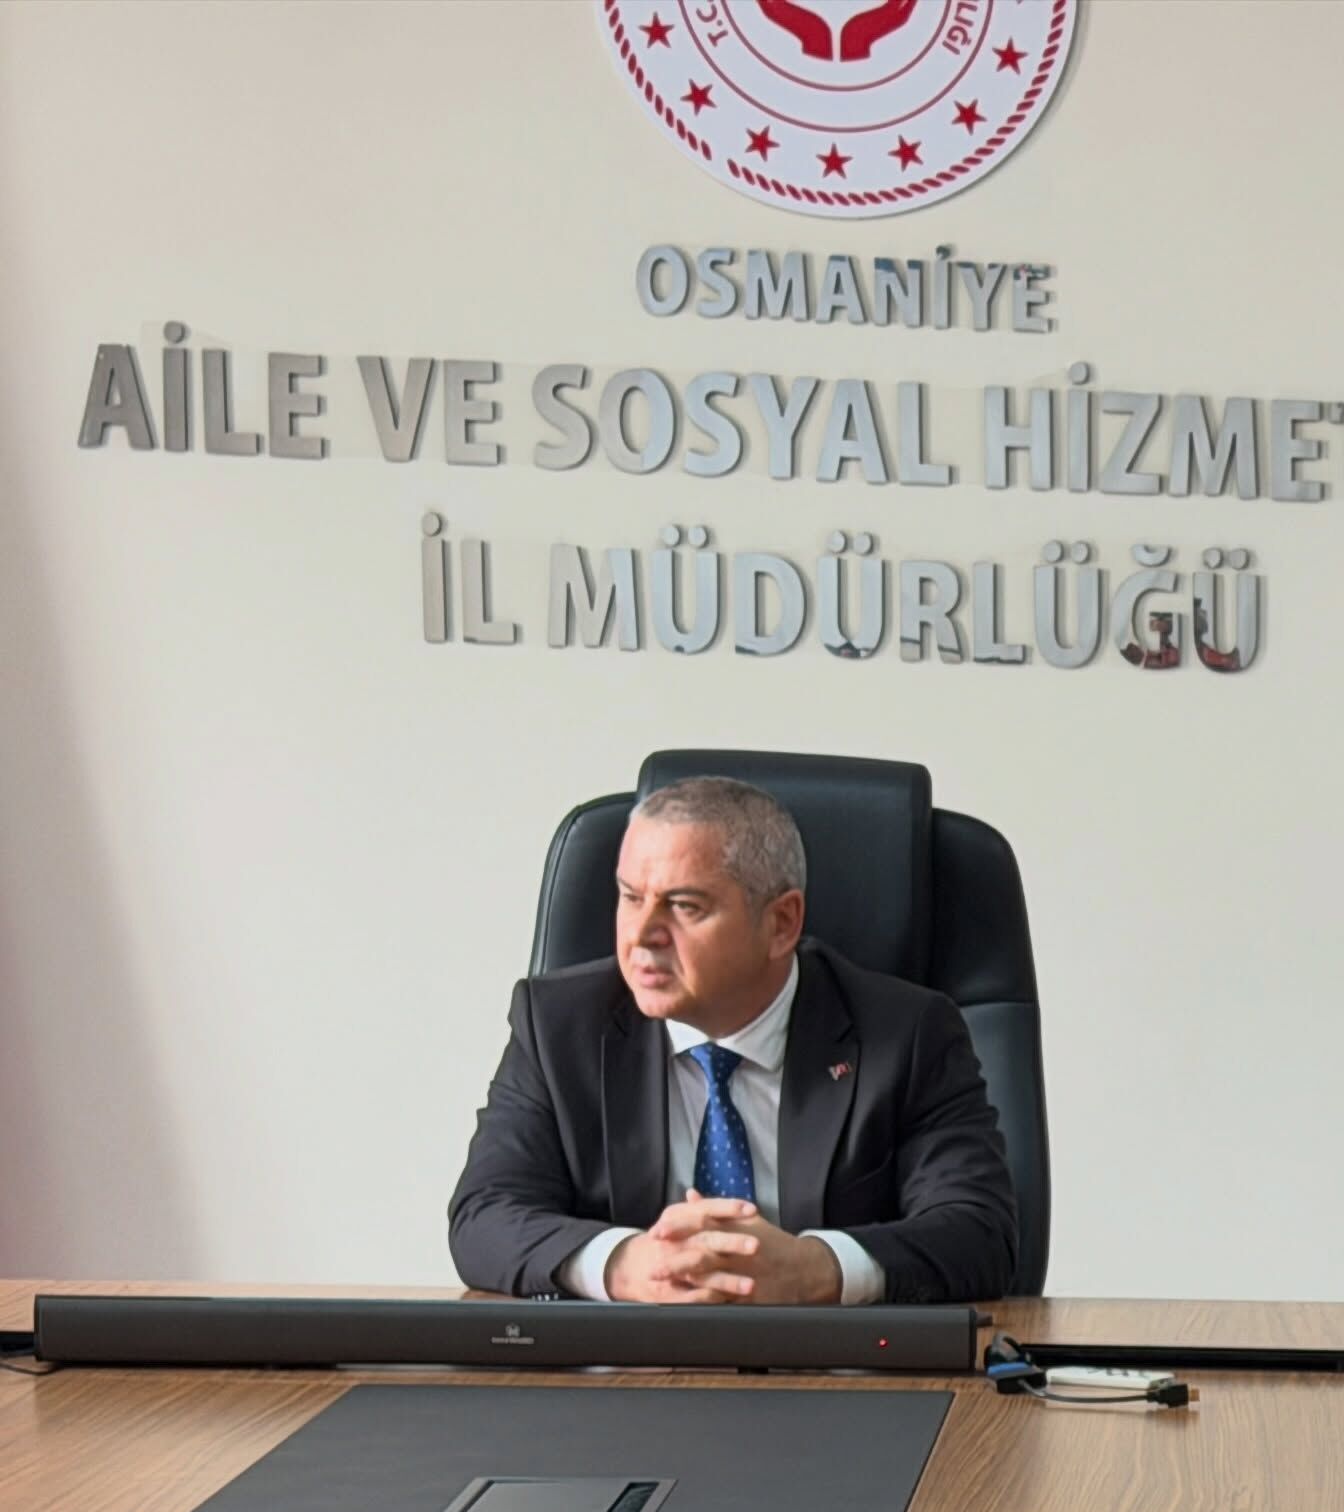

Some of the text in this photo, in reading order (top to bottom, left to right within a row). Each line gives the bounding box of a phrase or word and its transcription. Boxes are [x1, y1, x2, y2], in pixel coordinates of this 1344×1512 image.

[635, 244, 1056, 333] OSMANİYE
[77, 321, 327, 459] AİLE
[357, 355, 504, 466] VE
[532, 364, 953, 486] SOSYAL
[421, 512, 1268, 674] İL MÜDÜRLÜĞÜ
